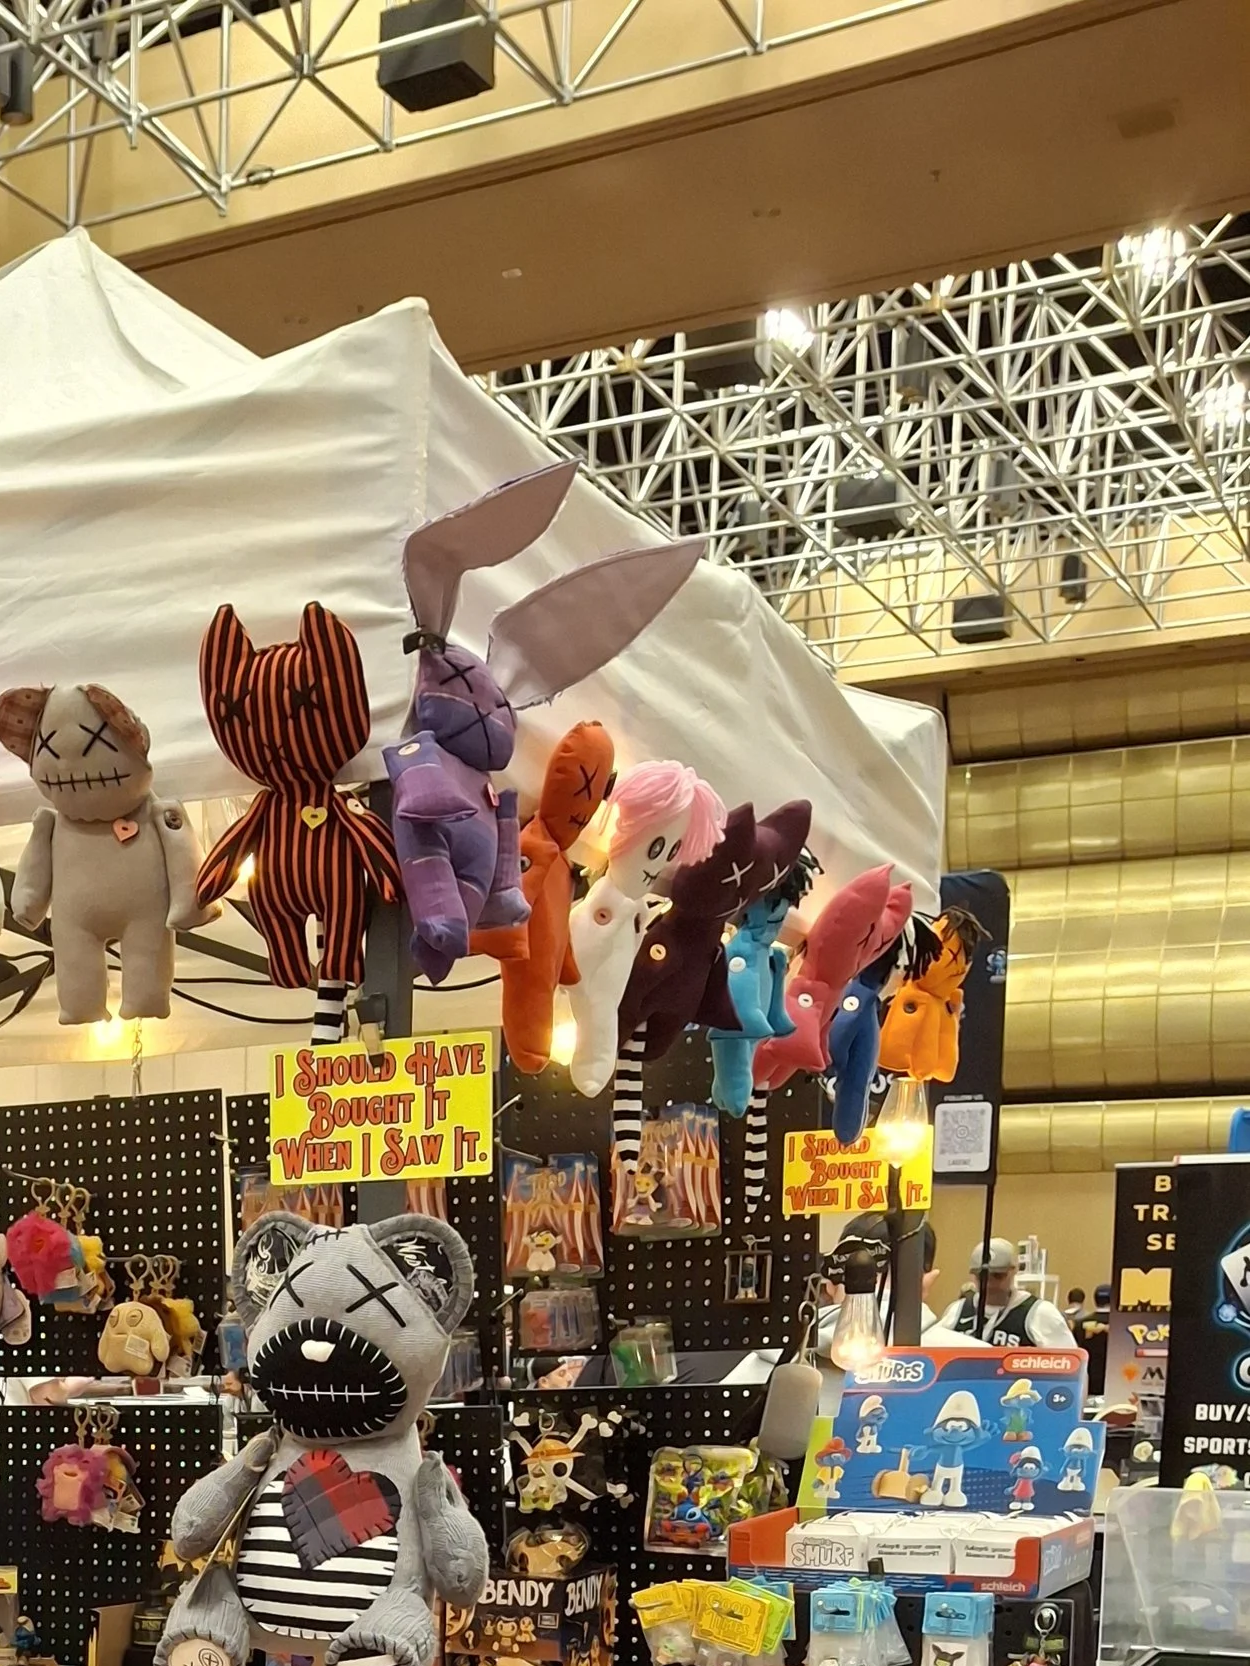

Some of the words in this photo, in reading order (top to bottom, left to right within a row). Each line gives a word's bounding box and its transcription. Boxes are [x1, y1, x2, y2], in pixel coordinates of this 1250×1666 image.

[275, 1055, 284, 1098] I
[293, 1049, 396, 1096] SHOULD
[405, 1041, 485, 1085] HAVE
[308, 1092, 415, 1138] BOUGHT
[425, 1084, 450, 1130] IT
[274, 1132, 352, 1179] WHEN
[362, 1133, 371, 1177] I
[380, 1128, 443, 1176] SAW
[454, 1127, 487, 1172] IT.
[789, 1136, 795, 1163] I
[810, 1159, 881, 1188] BOUGHT
[785, 1183, 838, 1210] WHEN
[845, 1184, 851, 1210] I
[1012, 1357, 1071, 1370] schleich
[791, 1541, 854, 1568] SMURF
[478, 1579, 554, 1608] BENDY
[564, 1574, 603, 1616] BENDY
[981, 1582, 1025, 1593] schleich
